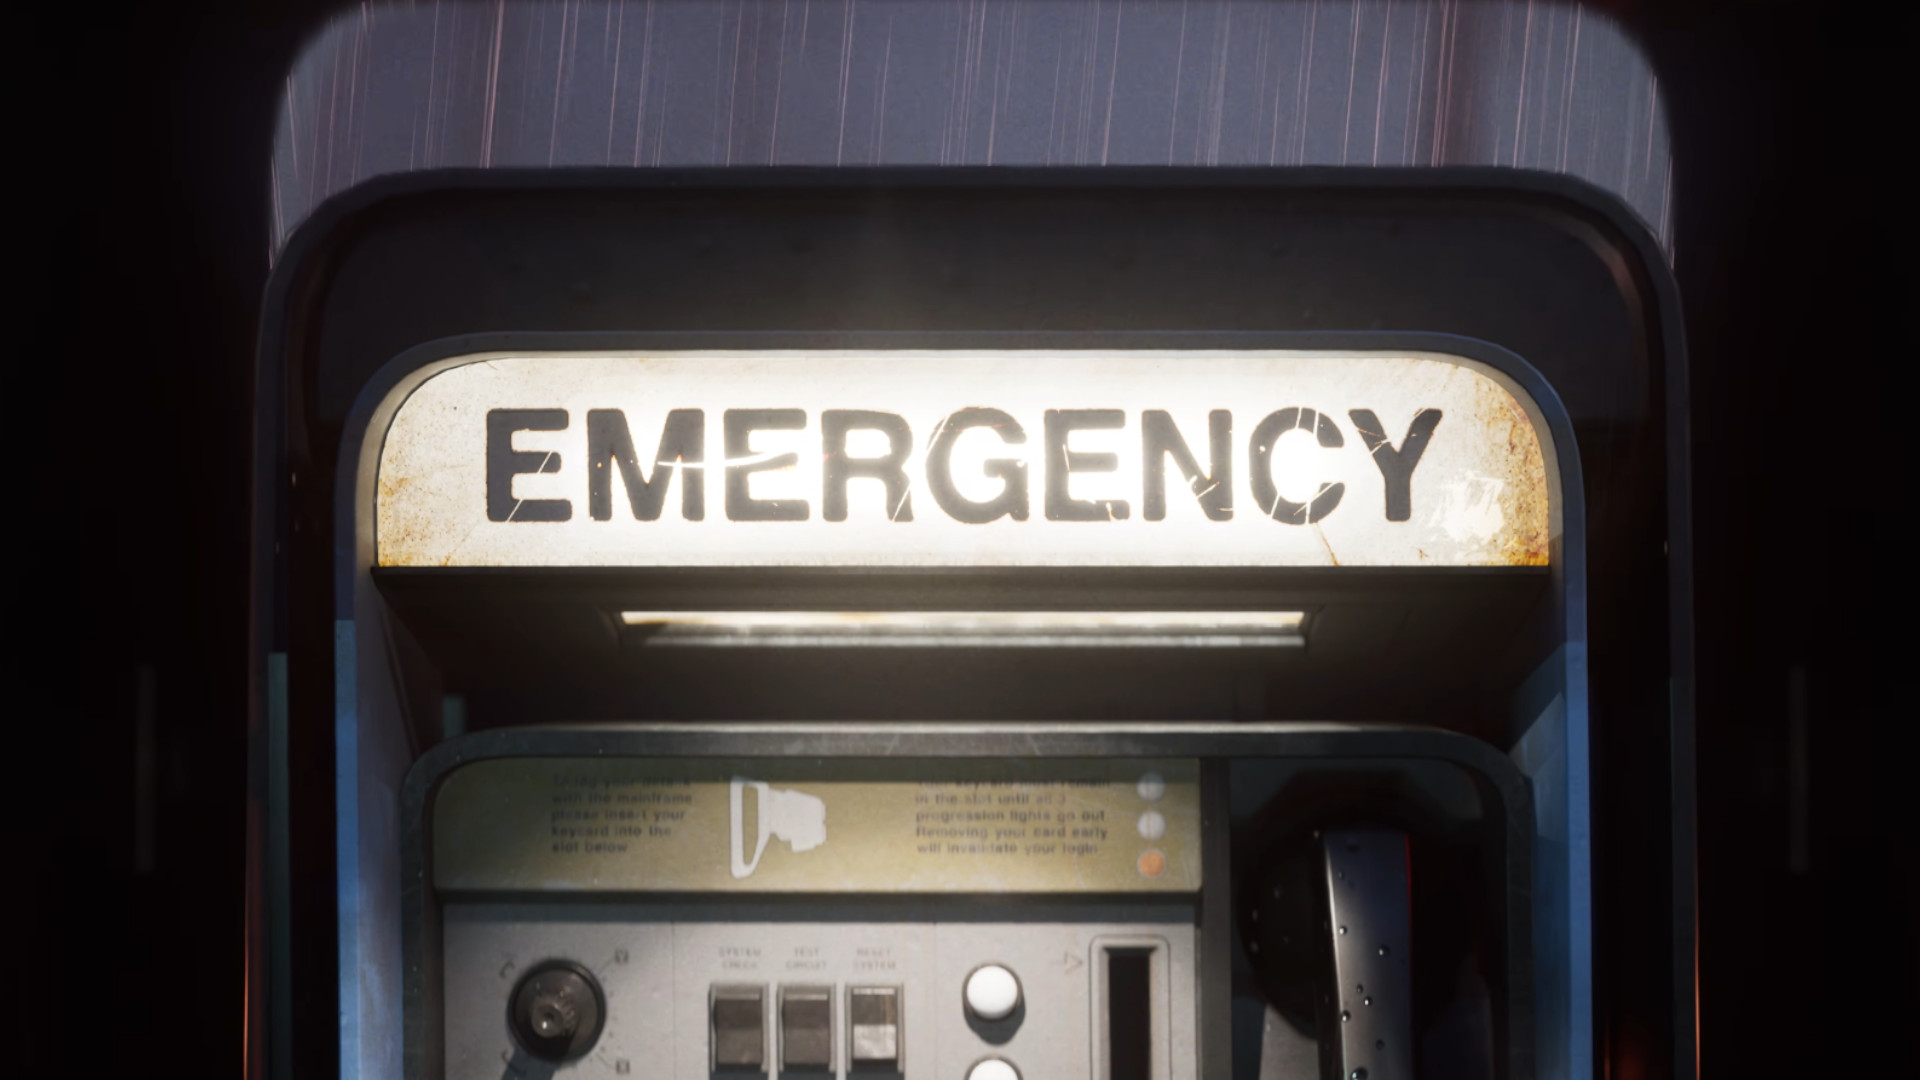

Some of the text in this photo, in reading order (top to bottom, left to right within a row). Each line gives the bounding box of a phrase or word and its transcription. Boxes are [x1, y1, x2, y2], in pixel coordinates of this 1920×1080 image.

[486, 407, 1444, 525] EMERGENCY
[552, 792, 692, 804] with the mainframe
[915, 794, 929, 805] in
[935, 793, 958, 805] the
[964, 793, 991, 805] slot
[997, 793, 1029, 805] until
[1036, 794, 1052, 805] all
[551, 809, 685, 822] please insert your
[916, 810, 1105, 823] progression lights go out
[551, 825, 672, 838] keycard into the
[916, 827, 1108, 840] Removing your card early
[552, 841, 628, 853] slot below
[917, 843, 1099, 857] will invalidate your login
